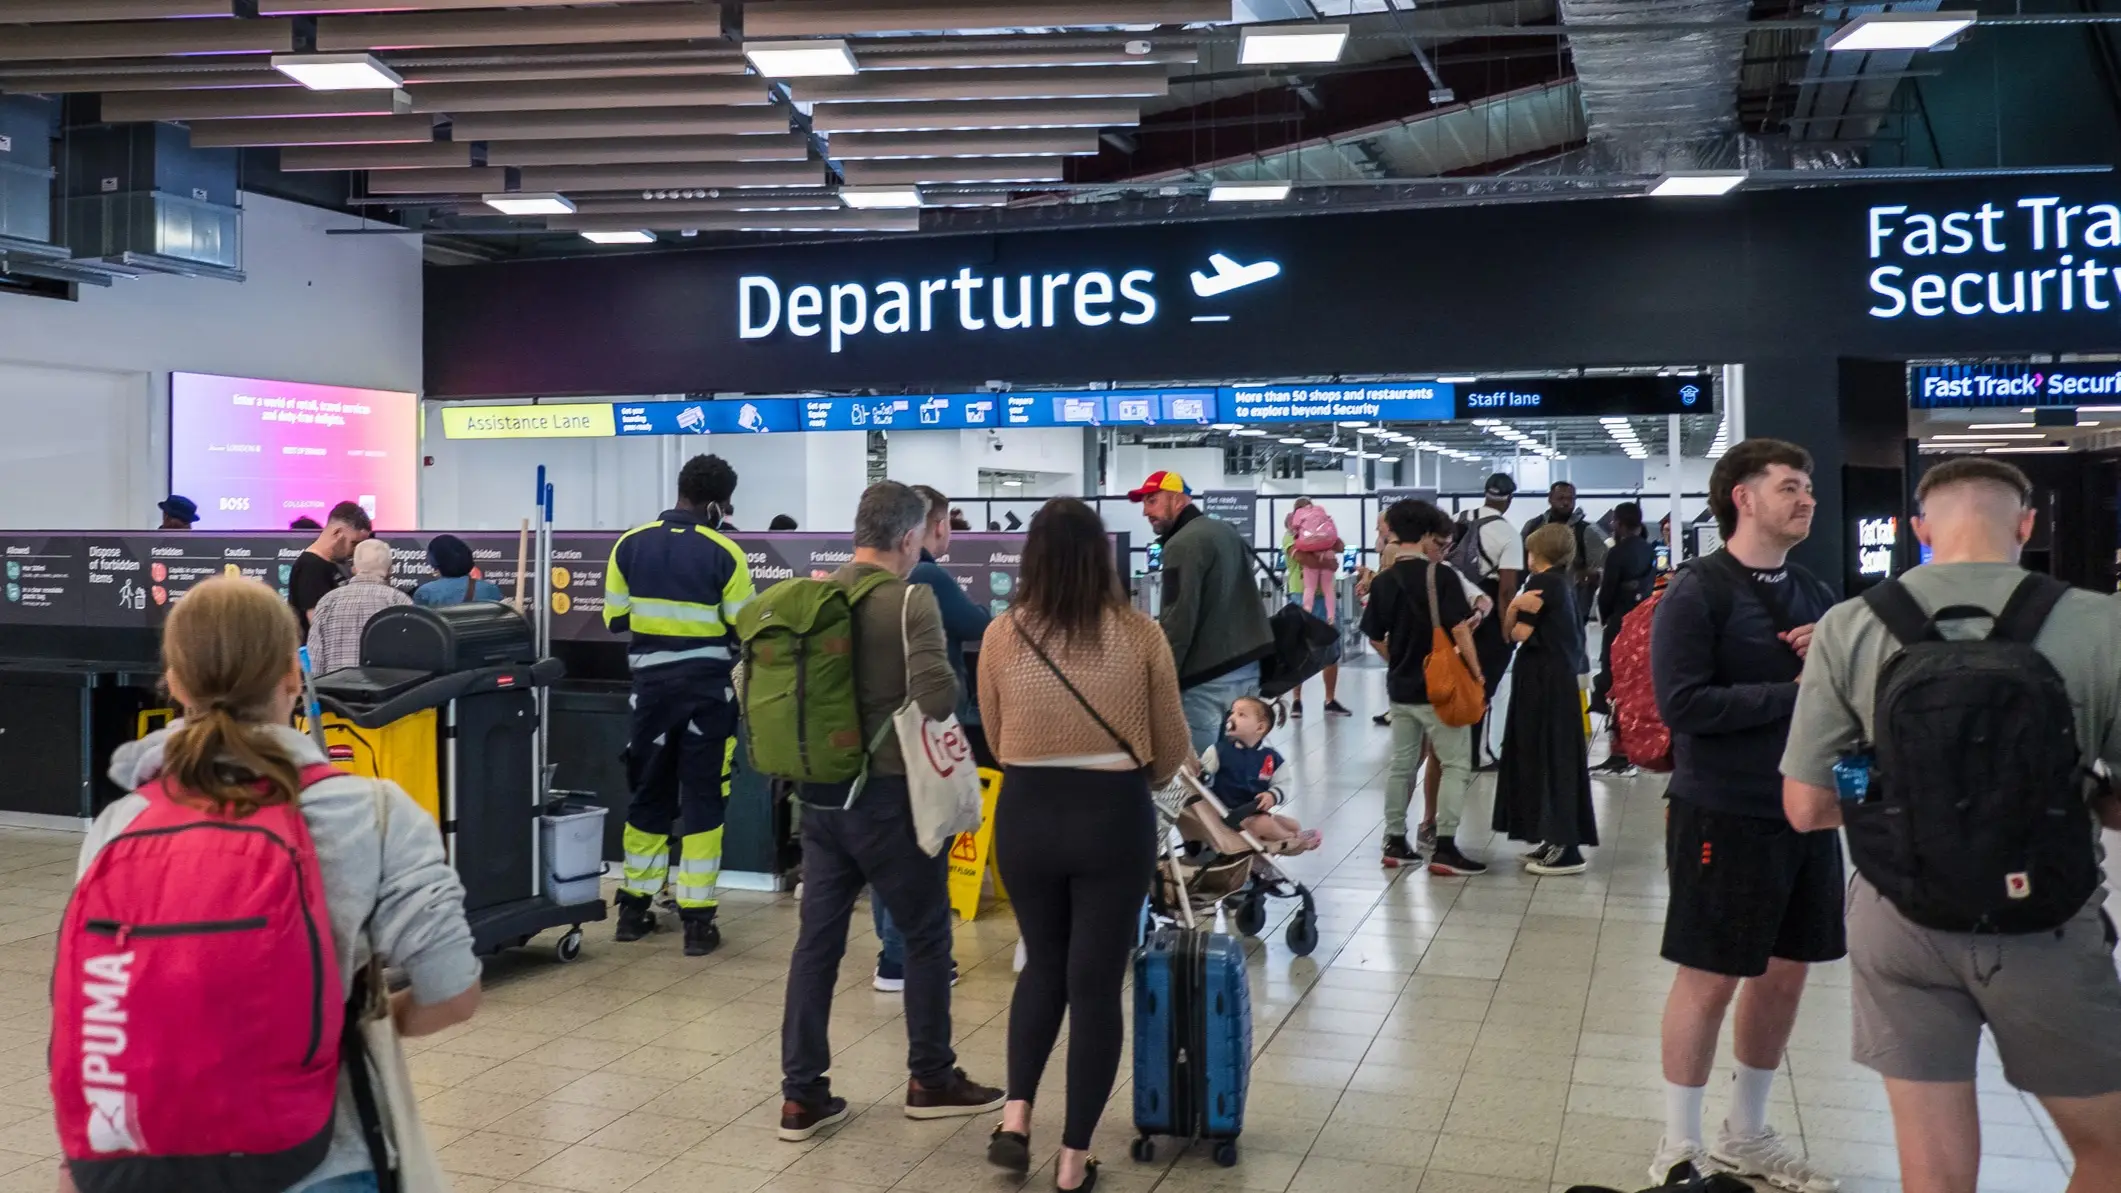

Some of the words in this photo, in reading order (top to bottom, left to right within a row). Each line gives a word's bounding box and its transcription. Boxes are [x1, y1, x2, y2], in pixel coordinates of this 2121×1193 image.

[1868, 202, 2006, 259] Fast
[738, 267, 1156, 354] Departures
[1924, 375, 1973, 398] Fast
[1974, 373, 2037, 396] Track
[1235, 391, 1263, 404] More
[1264, 391, 1291, 403] than
[1292, 390, 1307, 402] 50
[1308, 389, 1342, 404] shops
[1343, 387, 1365, 401] and
[1366, 387, 1434, 401] restaurants
[1468, 391, 1506, 407] Staff
[1508, 391, 1541, 406] lane
[1236, 405, 1249, 418] to
[1250, 404, 1290, 419] explore
[1291, 403, 1332, 418] beyond
[1332, 402, 1380, 417] Security
[467, 414, 549, 431] Assistance
[553, 413, 591, 430] Lane
[219, 496, 250, 511] BOSS
[89, 545, 121, 559] Dispose
[151, 547, 184, 556] Forbidden
[224, 547, 251, 557] Caution
[390, 547, 427, 562] Dispose
[551, 550, 582, 560] Caution
[989, 552, 1021, 563] Allowe
[89, 559, 99, 570] of
[100, 559, 140, 571] forbidden
[750, 565, 793, 579] rbidden
[89, 572, 113, 583] items
[81, 951, 136, 1087] PUMA
